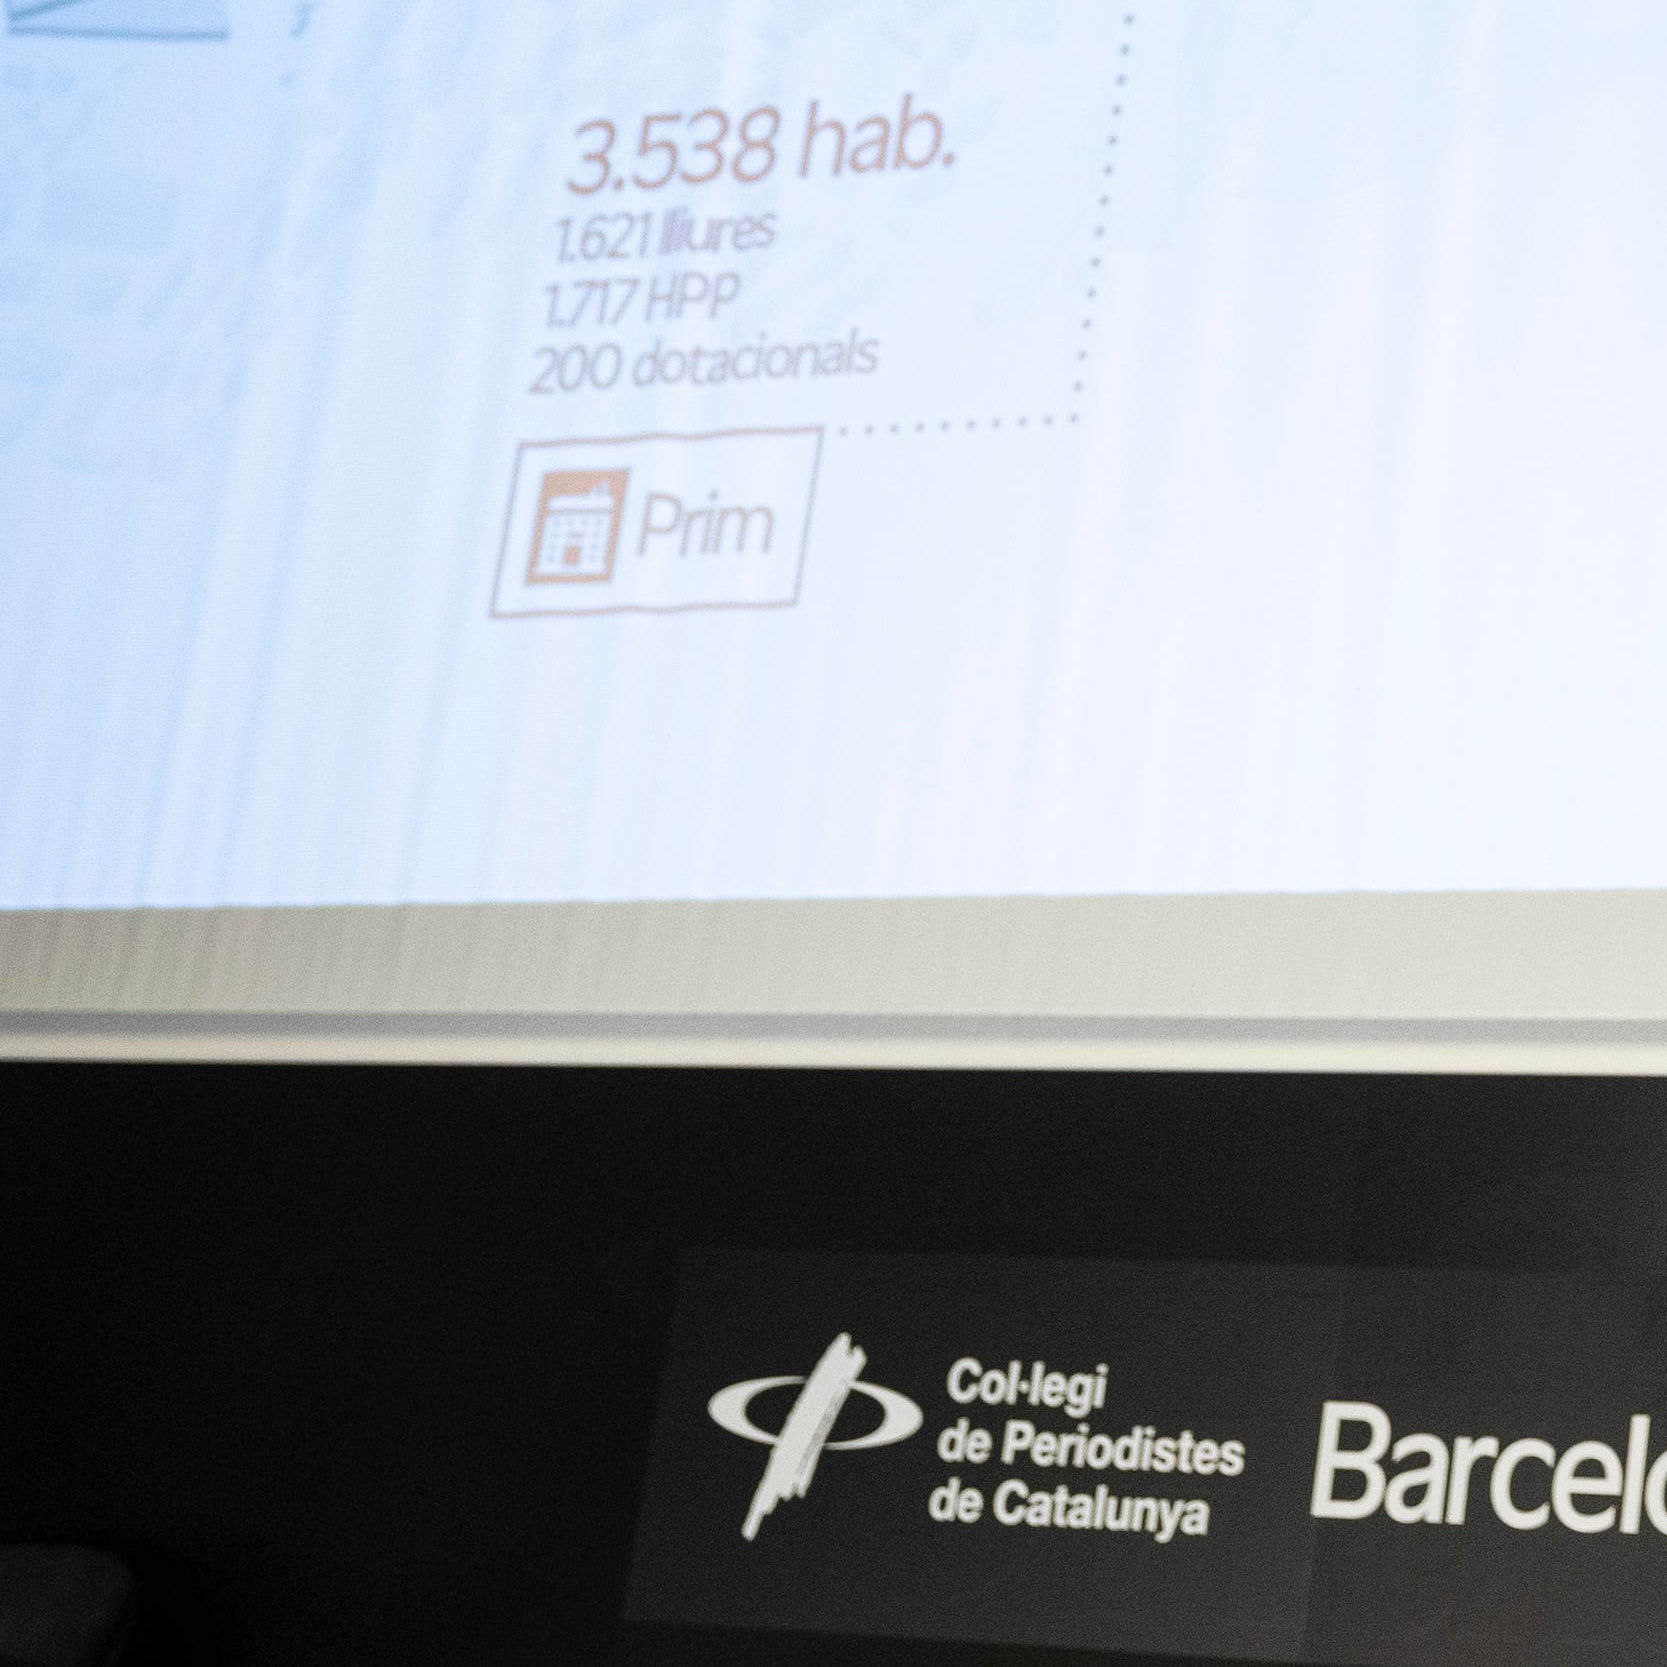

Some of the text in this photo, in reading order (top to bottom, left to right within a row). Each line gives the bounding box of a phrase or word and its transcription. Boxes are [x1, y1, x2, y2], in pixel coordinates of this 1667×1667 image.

[566, 93, 955, 196] 3.538 hab.
[659, 206, 776, 254] lliures
[645, 271, 740, 321] HPP
[530, 327, 880, 393] 200 dotacionals
[637, 489, 774, 558] Prim
[947, 1357, 1109, 1418] Col·legi
[937, 1416, 1246, 1476] de Periodistes
[929, 1476, 1210, 1543] de Catalunya
